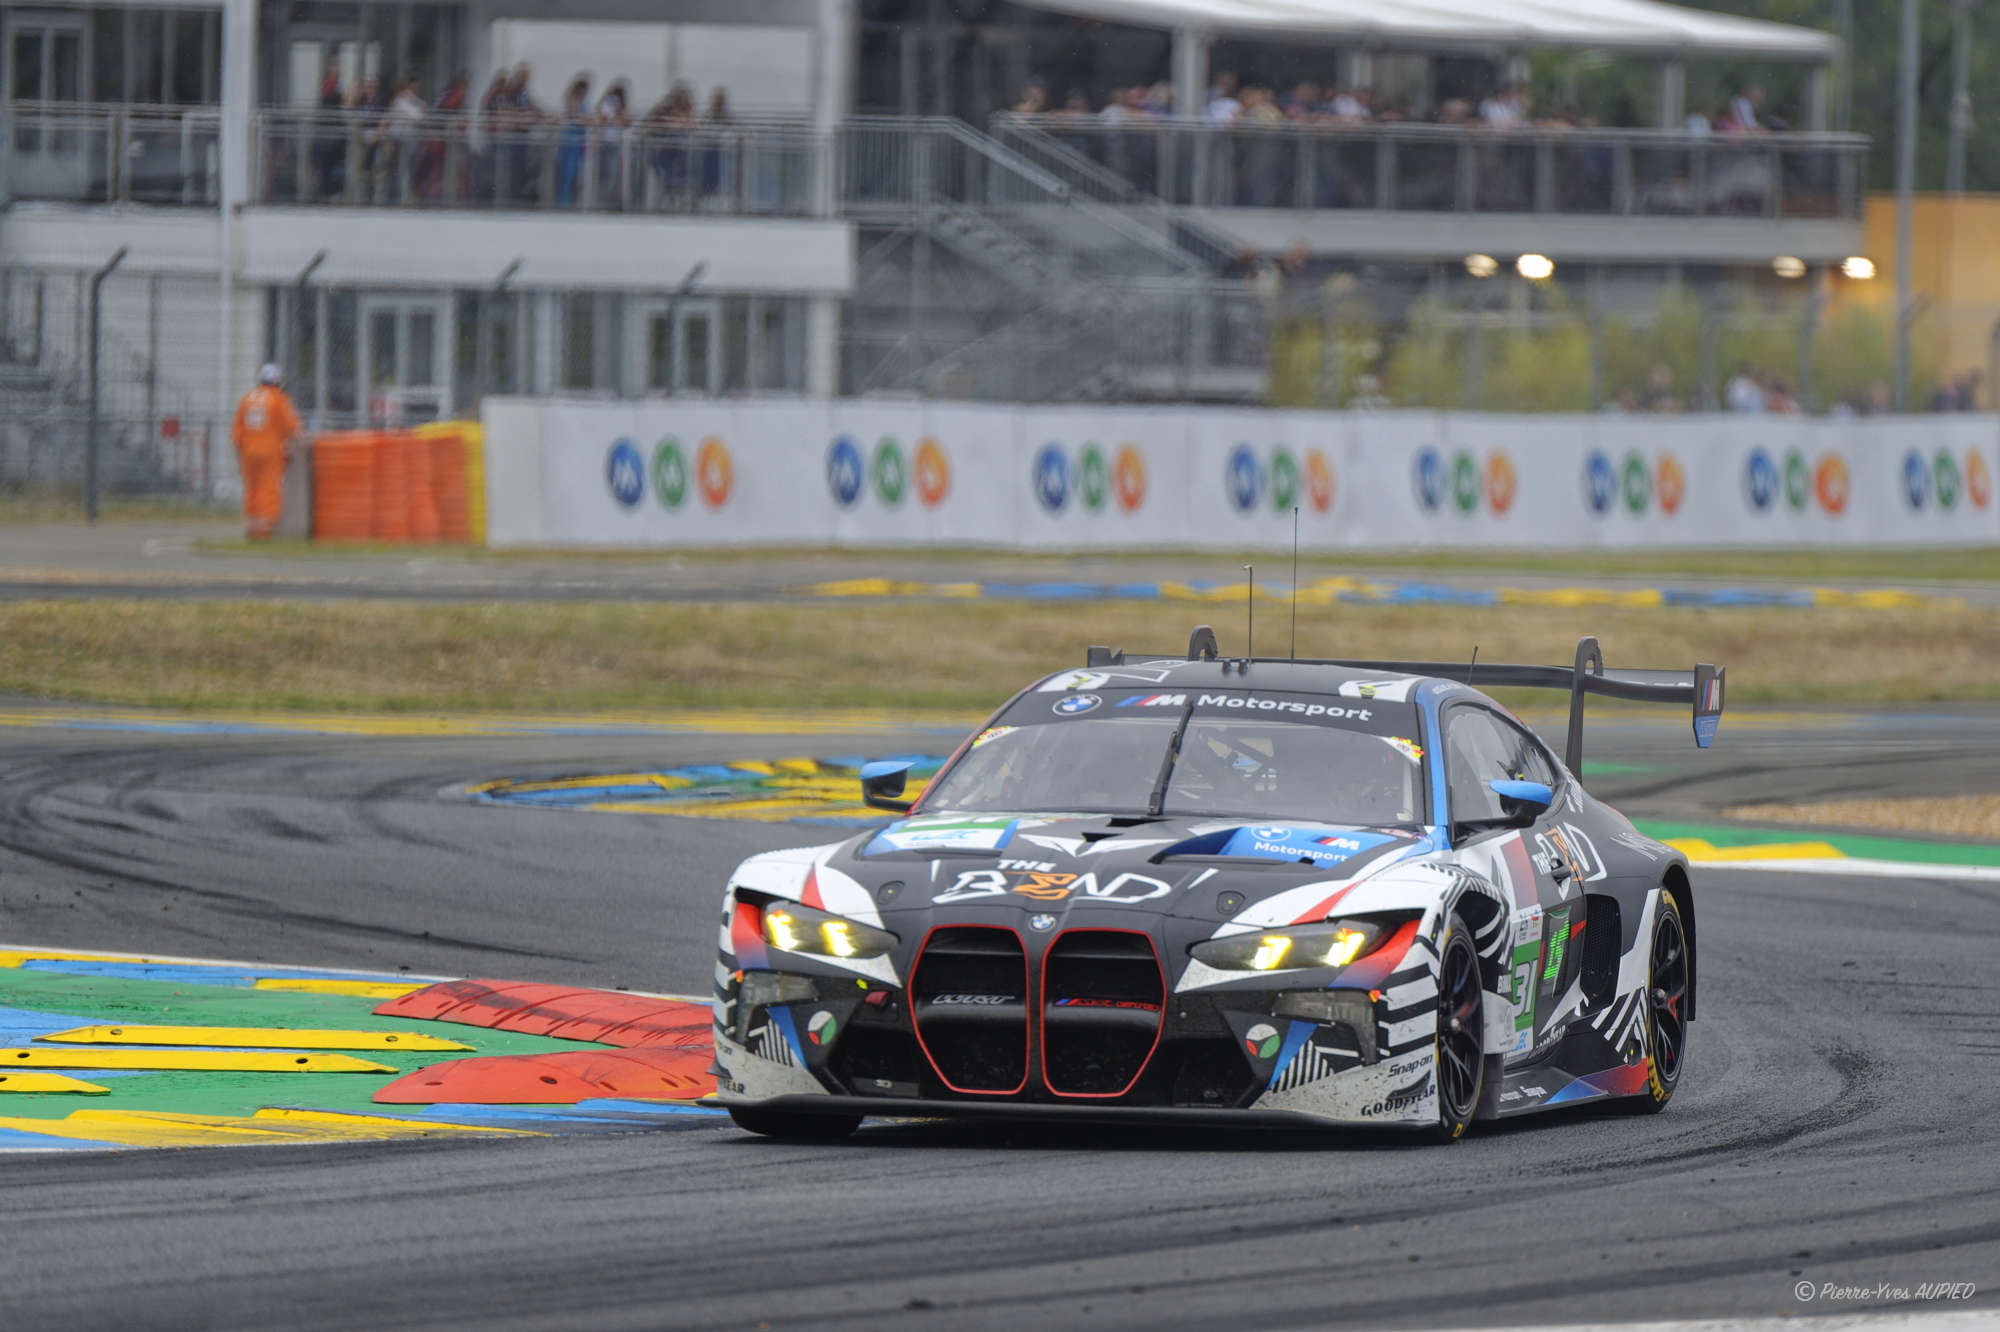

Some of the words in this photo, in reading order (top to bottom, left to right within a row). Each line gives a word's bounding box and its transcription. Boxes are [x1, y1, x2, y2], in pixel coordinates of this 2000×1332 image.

[1198, 694, 1373, 722] Motorsport
[1254, 841, 1348, 863] Motorsport
[998, 858, 1057, 873] THE
[1513, 957, 1539, 1019] 31
[1387, 1053, 1434, 1078] Snap-on
[1360, 1084, 1437, 1117] GOODYEAR
